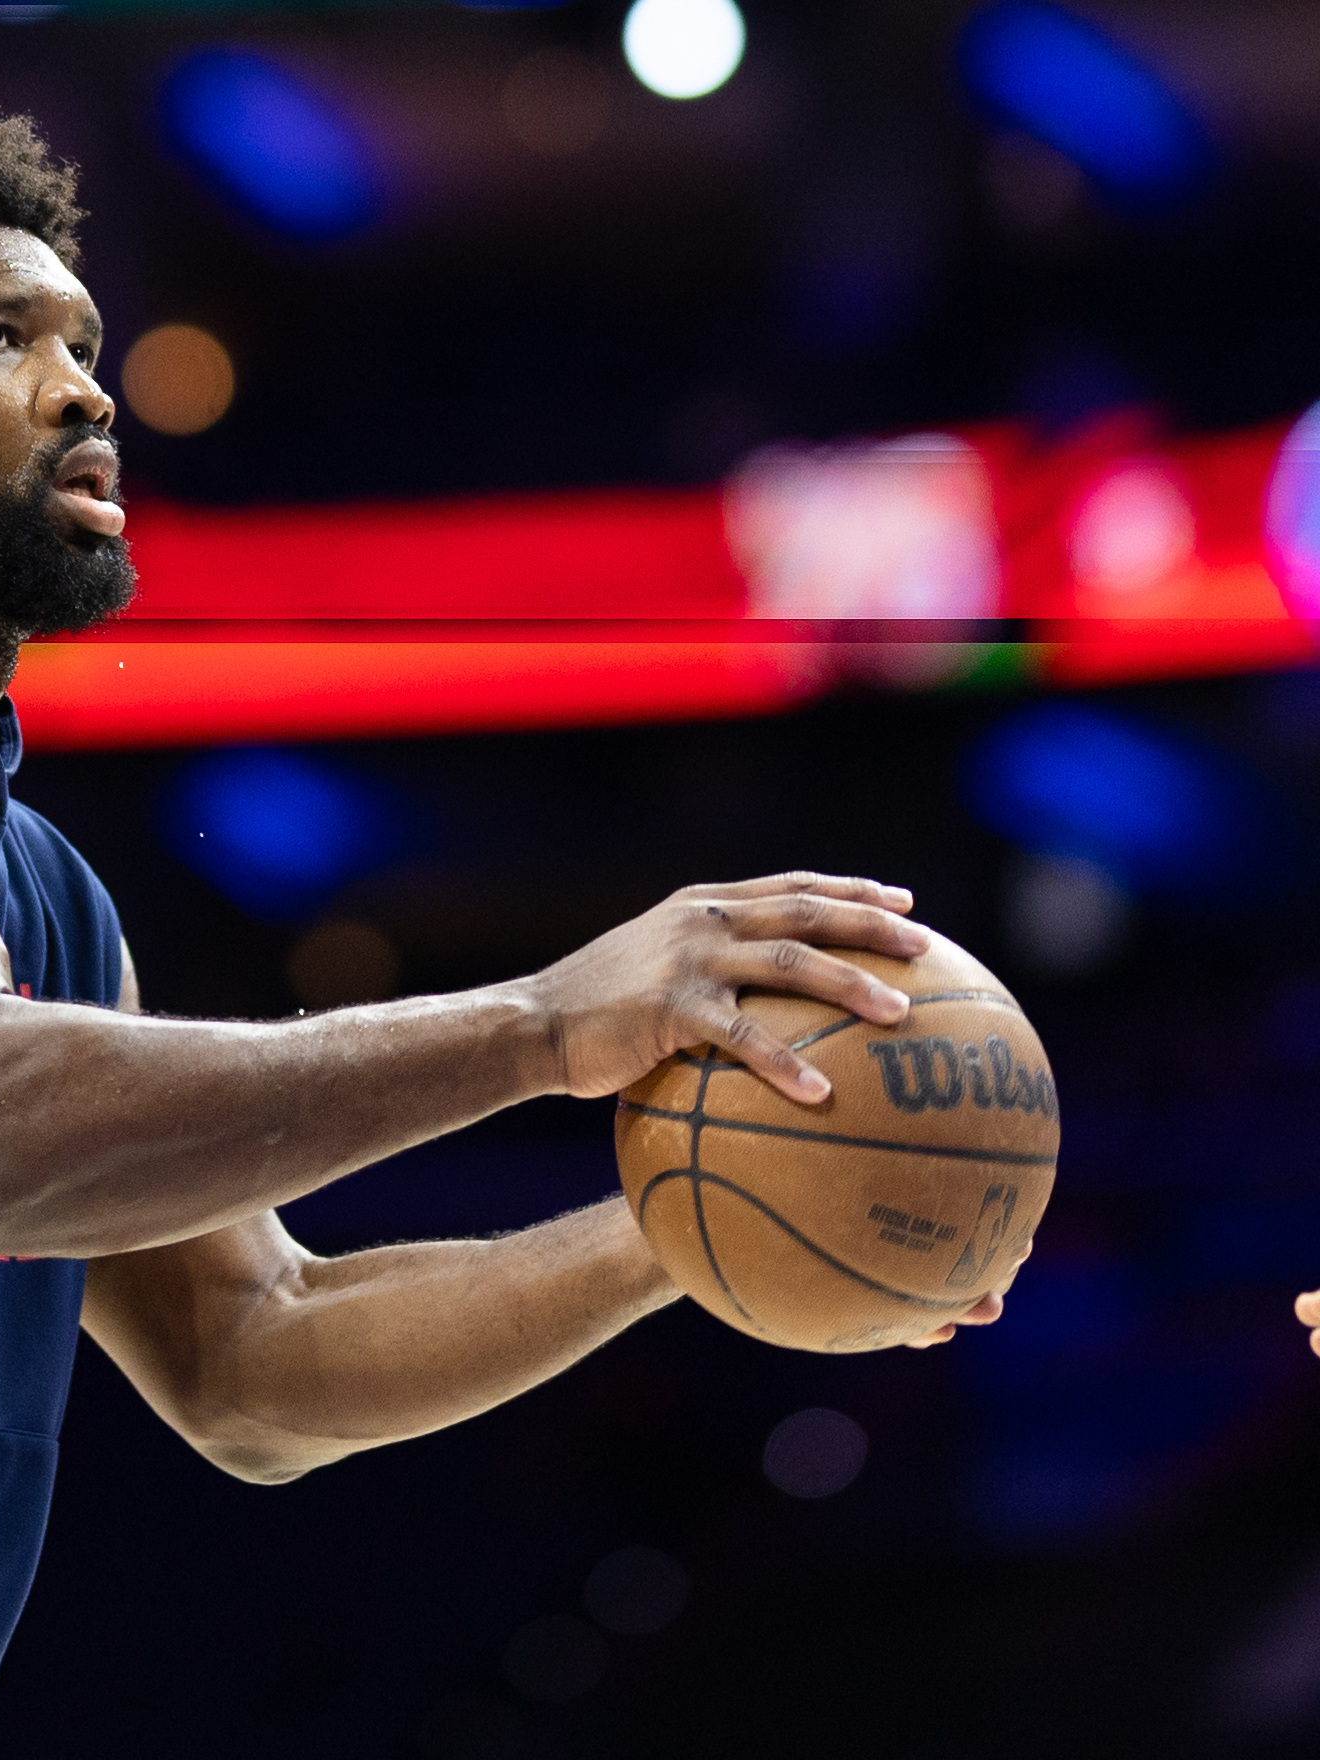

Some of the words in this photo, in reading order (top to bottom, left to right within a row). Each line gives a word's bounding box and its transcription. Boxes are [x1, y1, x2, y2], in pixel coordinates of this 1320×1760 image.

[867, 1034, 1059, 1123] Wilso
[867, 1203, 911, 1230] OFFICIAL
[910, 1216, 937, 1236] GAME
[935, 1224, 958, 1242] BALL
